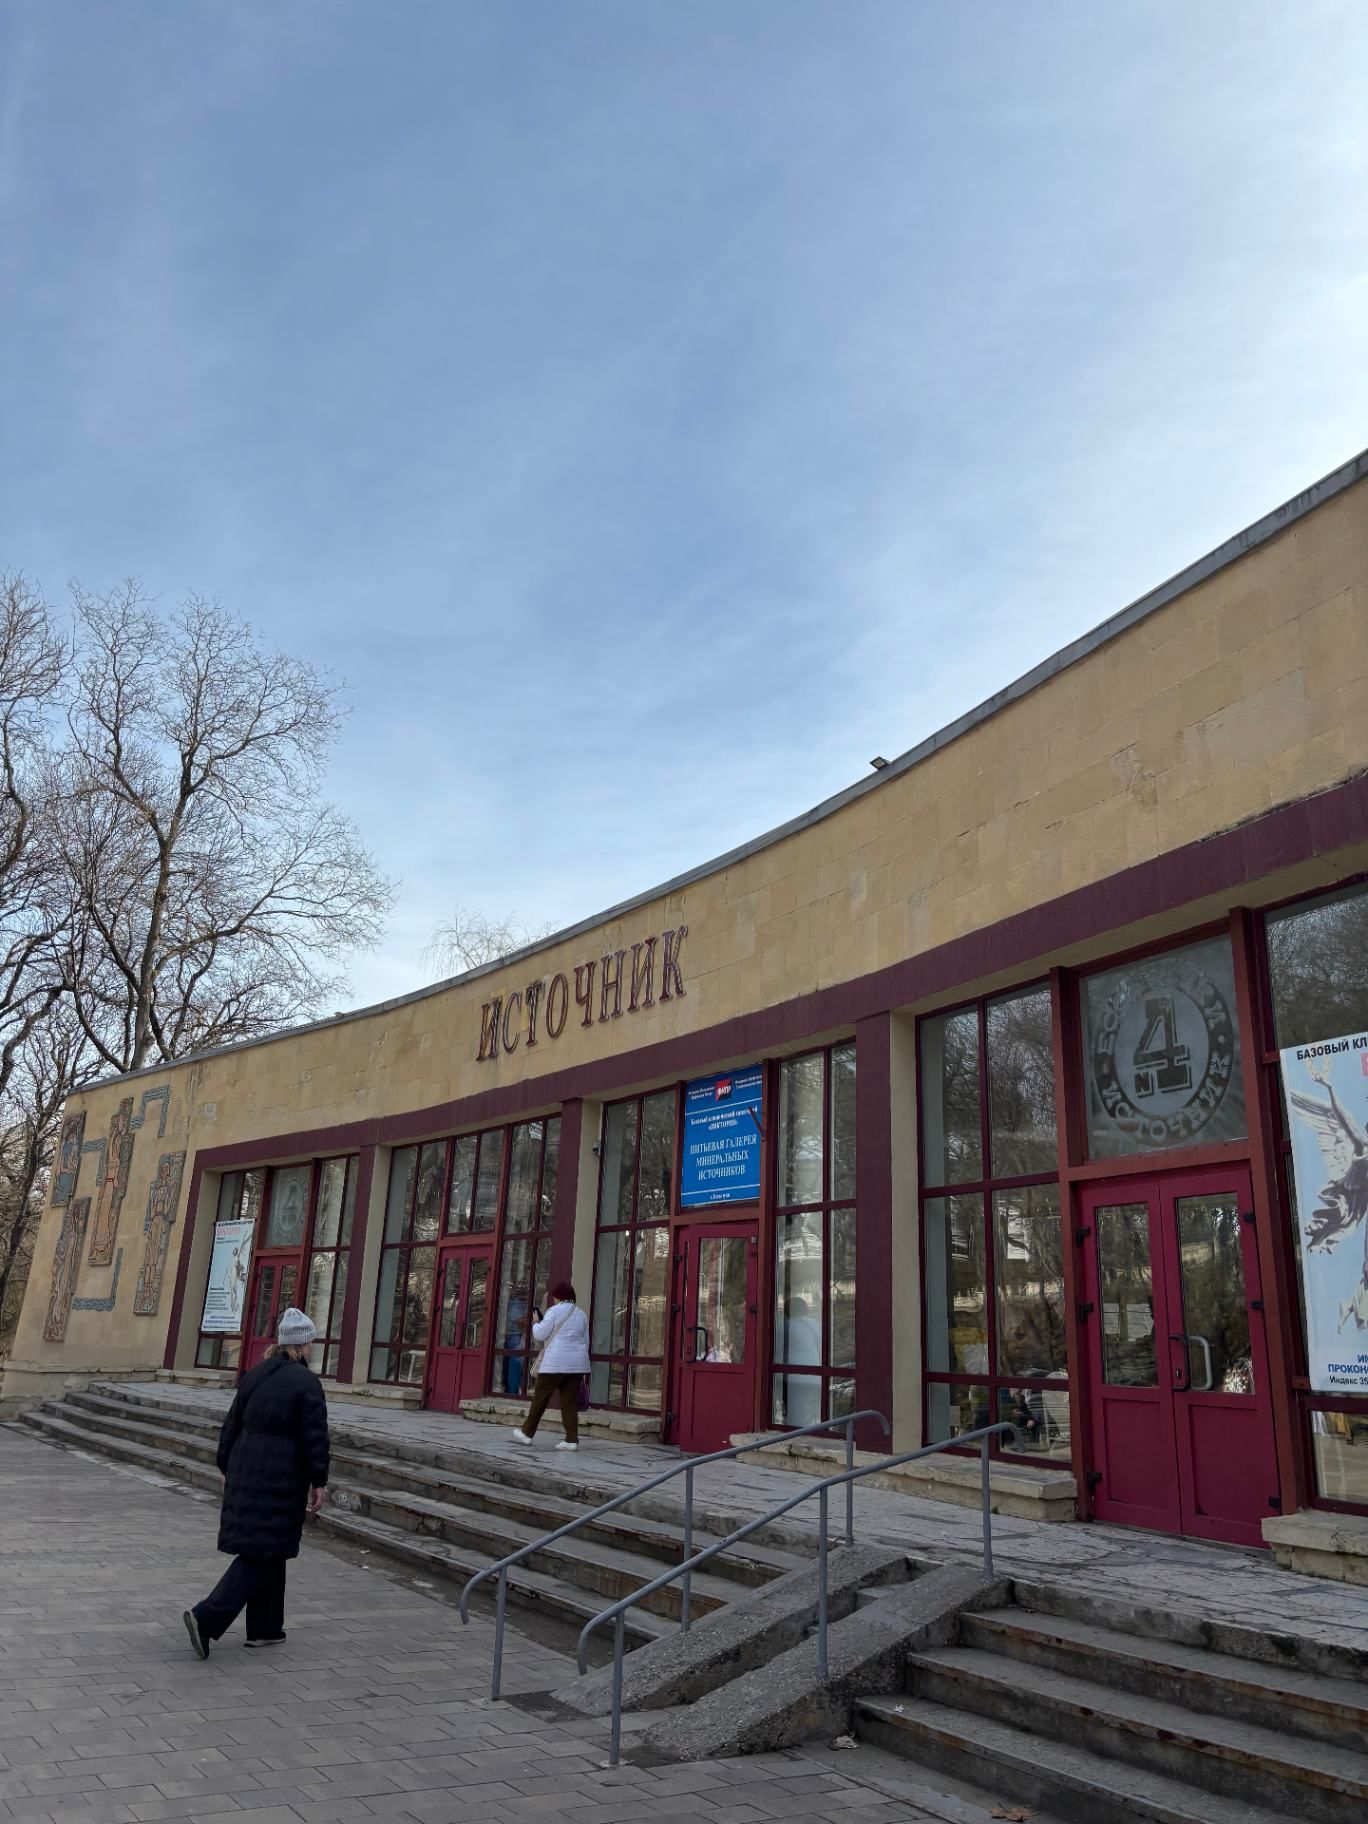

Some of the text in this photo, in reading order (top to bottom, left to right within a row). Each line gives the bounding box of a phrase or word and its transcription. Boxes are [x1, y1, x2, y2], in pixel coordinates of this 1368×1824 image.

[475, 924, 689, 1062] ИСТОЧНИК
[1296, 1039, 1350, 1061] БАЗОВЫЙ
[690, 1133, 757, 1155] ПИТЬЕВАЯ ГАЛЕРЕЯ
[695, 1149, 749, 1168] МИНЕРАЛЬНЫХ
[698, 1164, 746, 1181] ИСТОЧНИКОВ
[1328, 1364, 1368, 1374] ПРОКОН
[1329, 1375, 1358, 1385] Индекс
